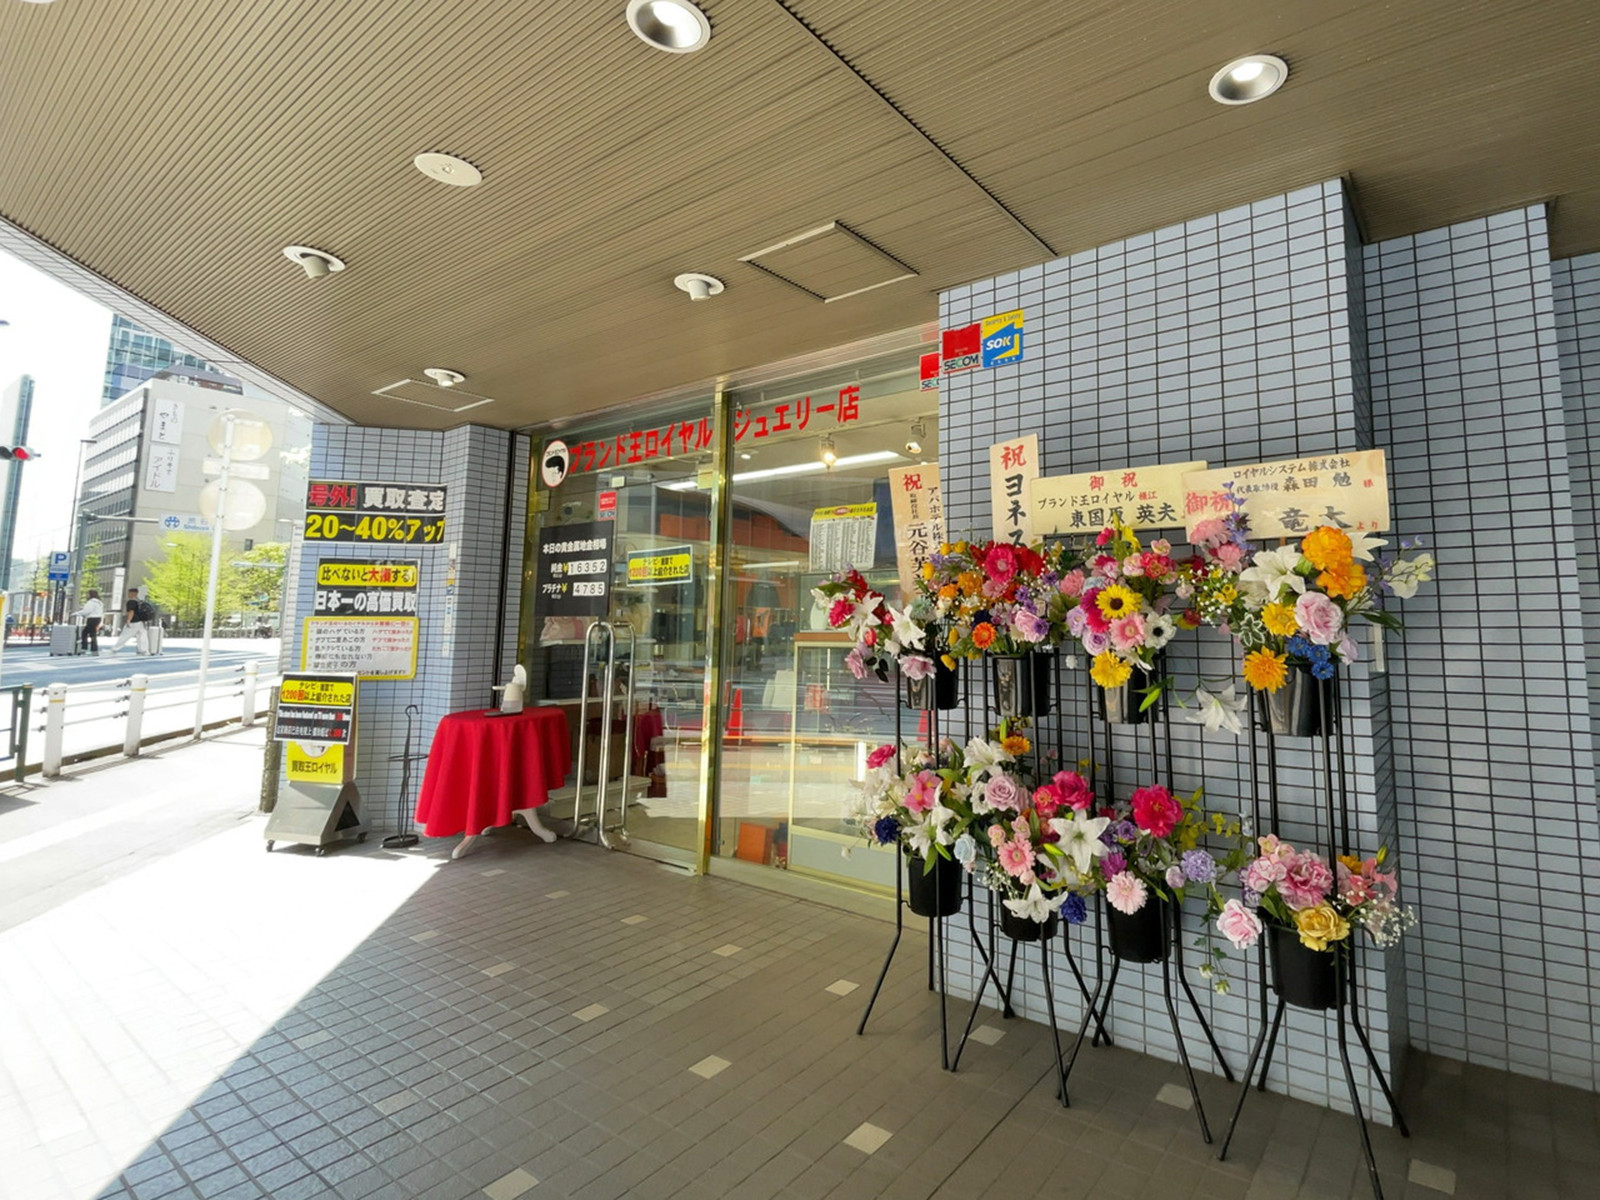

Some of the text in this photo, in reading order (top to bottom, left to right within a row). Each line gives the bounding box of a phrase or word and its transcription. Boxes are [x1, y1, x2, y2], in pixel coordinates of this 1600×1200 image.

[944, 354, 979, 371] SECOM
[569, 386, 860, 474] ブランド王ロイヤル ジュエリー店
[1000, 445, 1026, 470] 祝
[1233, 457, 1351, 480] ロイヤルシステム株式会社
[903, 473, 923, 492] 祝
[363, 486, 445, 511] 買取査定
[1070, 502, 1177, 529] 東国原 英夫
[55, 553, 67, 564] P
[570, 560, 606, 573] 16352
[315, 589, 417, 612] 日本一の高価買取
[574, 583, 604, 595] 4785
